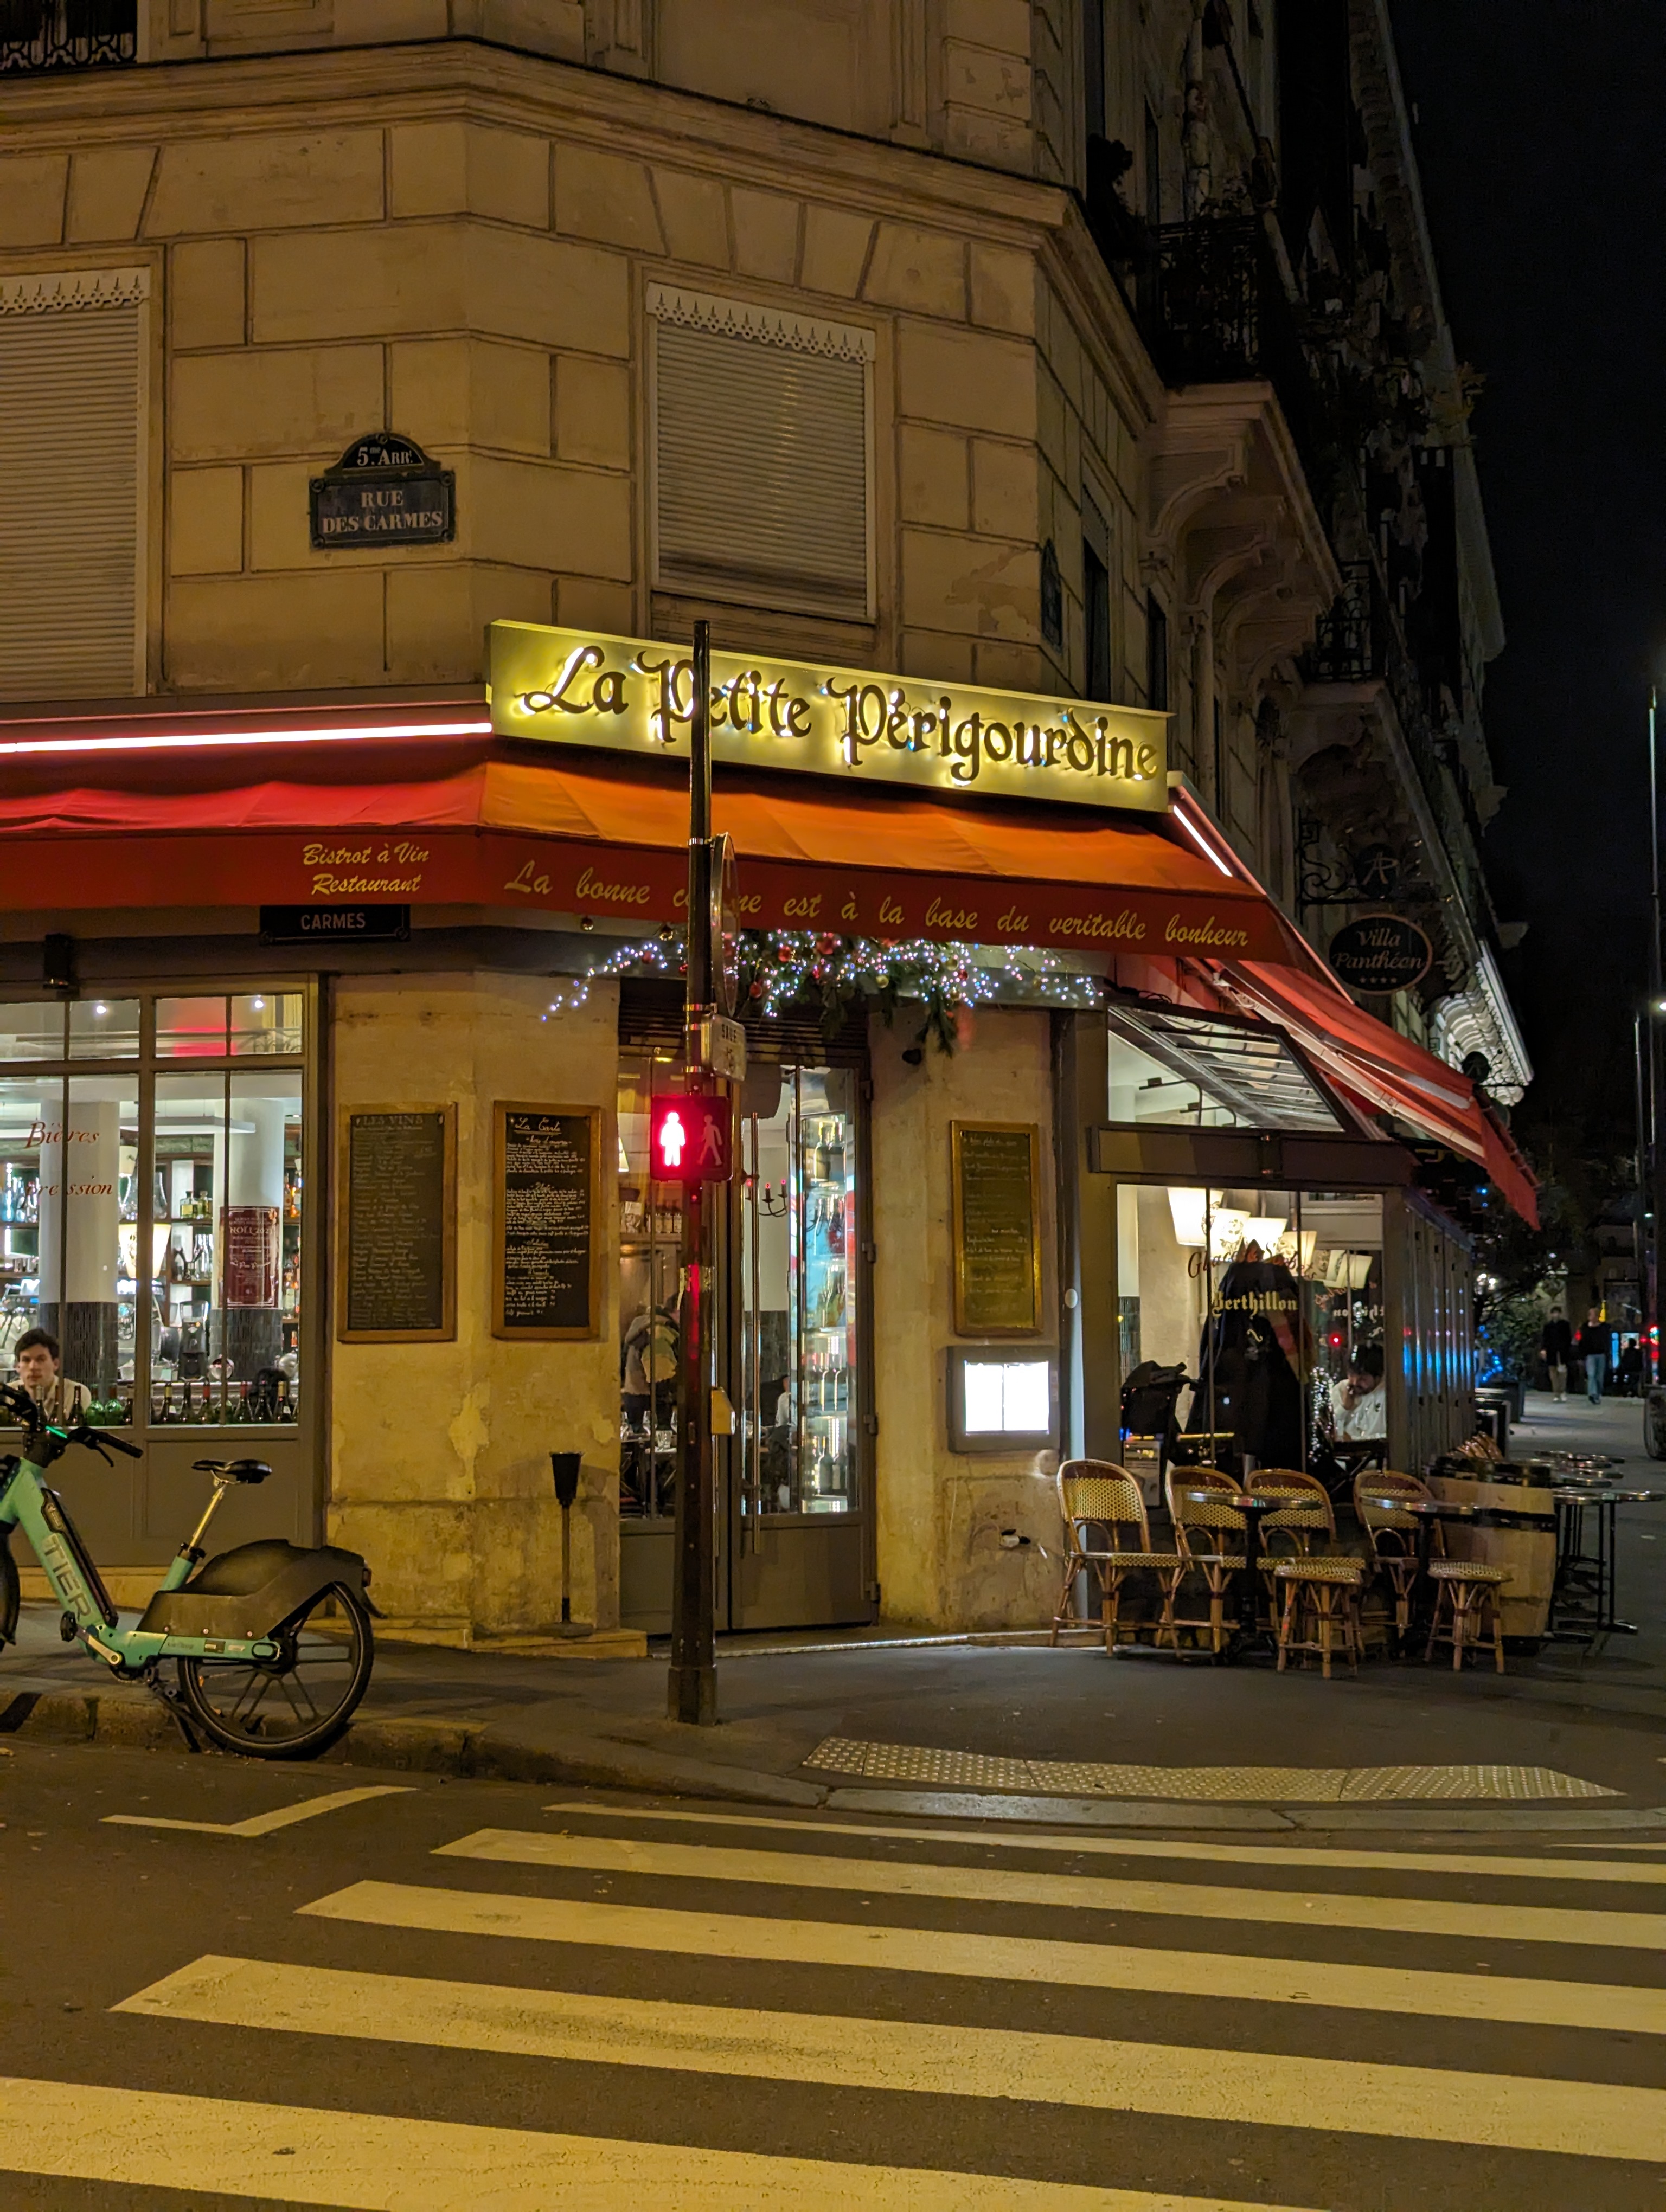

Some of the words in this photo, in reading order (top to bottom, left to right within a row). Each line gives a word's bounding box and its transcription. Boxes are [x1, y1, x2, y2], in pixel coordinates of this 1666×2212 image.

[361, 490, 403, 508] RUE
[323, 516, 360, 533] DES
[363, 511, 443, 531] CARMES
[515, 645, 629, 715] La
[637, 651, 812, 743] Petite
[826, 676, 1158, 782] Périgourdine
[302, 843, 373, 866] Bistrot
[377, 843, 391, 863] à
[394, 841, 430, 864] Vin
[311, 873, 422, 896] Restaurant
[504, 859, 553, 895] La
[576, 867, 651, 905] bonne
[783, 893, 822, 918] est
[841, 890, 858, 921] à
[879, 896, 905, 923] la
[925, 896, 978, 930] base
[997, 905, 1030, 933] du
[1049, 909, 1146, 940] veritable
[1164, 913, 1249, 947] bonheur
[301, 912, 366, 930] CARMES
[1356, 927, 1401, 947] Villa
[1331, 949, 1425, 969] Panthéon
[24, 1121, 100, 1149] Bières
[43, 1533, 92, 1623] TIER
